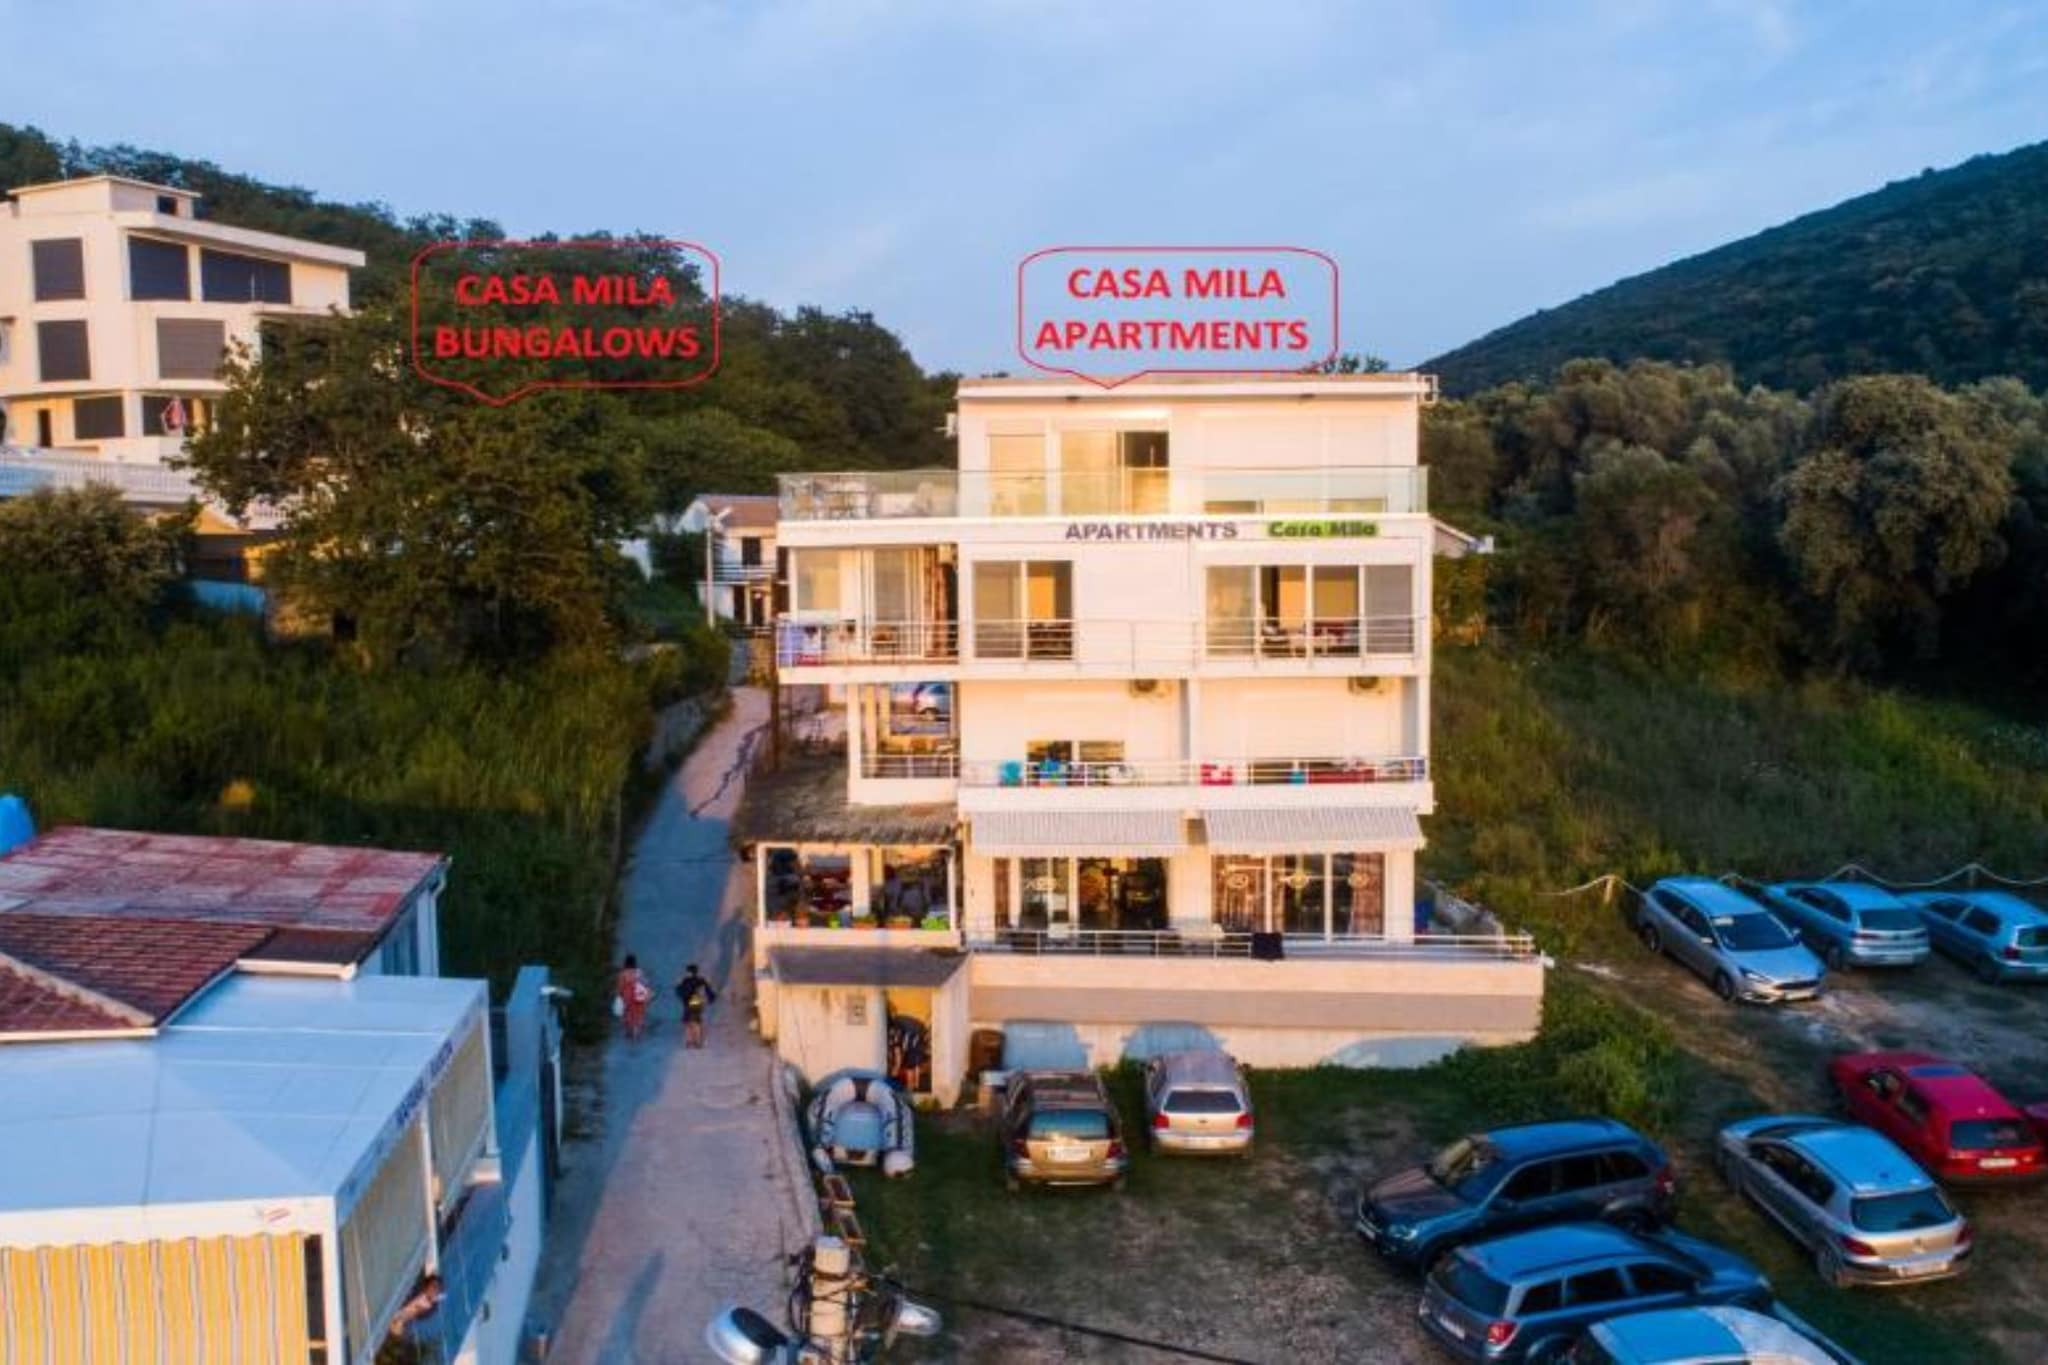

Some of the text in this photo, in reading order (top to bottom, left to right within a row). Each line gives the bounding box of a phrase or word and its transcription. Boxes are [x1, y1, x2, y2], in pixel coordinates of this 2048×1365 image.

[1065, 521, 1376, 540] APARTMENTS Casa Mila
